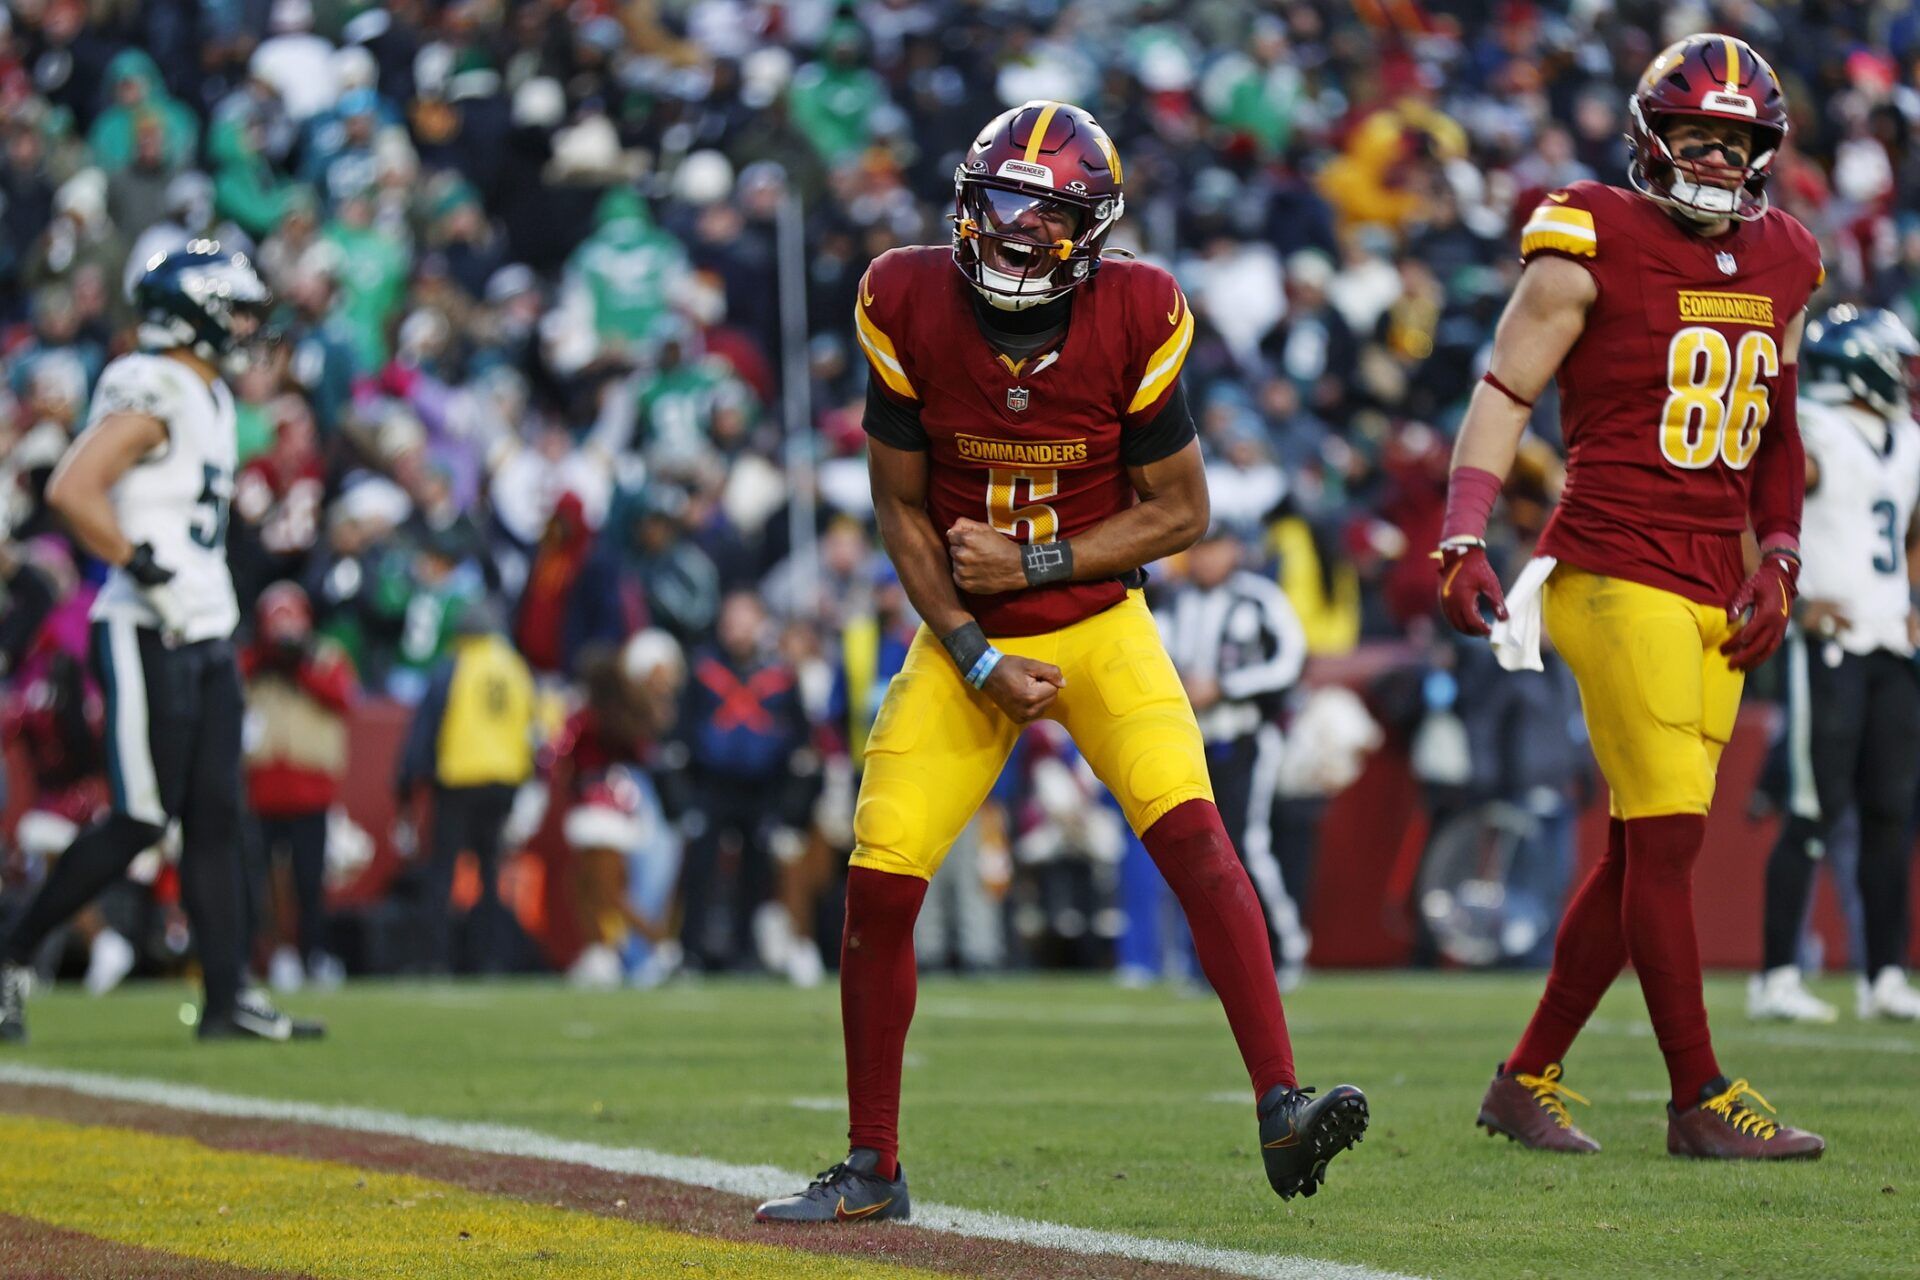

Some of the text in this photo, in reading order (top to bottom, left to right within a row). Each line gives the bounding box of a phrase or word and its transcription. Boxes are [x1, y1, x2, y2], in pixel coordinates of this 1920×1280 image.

[1679, 294, 1774, 322] COMMANDERS
[1660, 327, 1778, 470] 86
[957, 437, 1087, 463] COMMANDERS
[986, 467, 1059, 545] 5
[1871, 499, 1897, 574] 3
